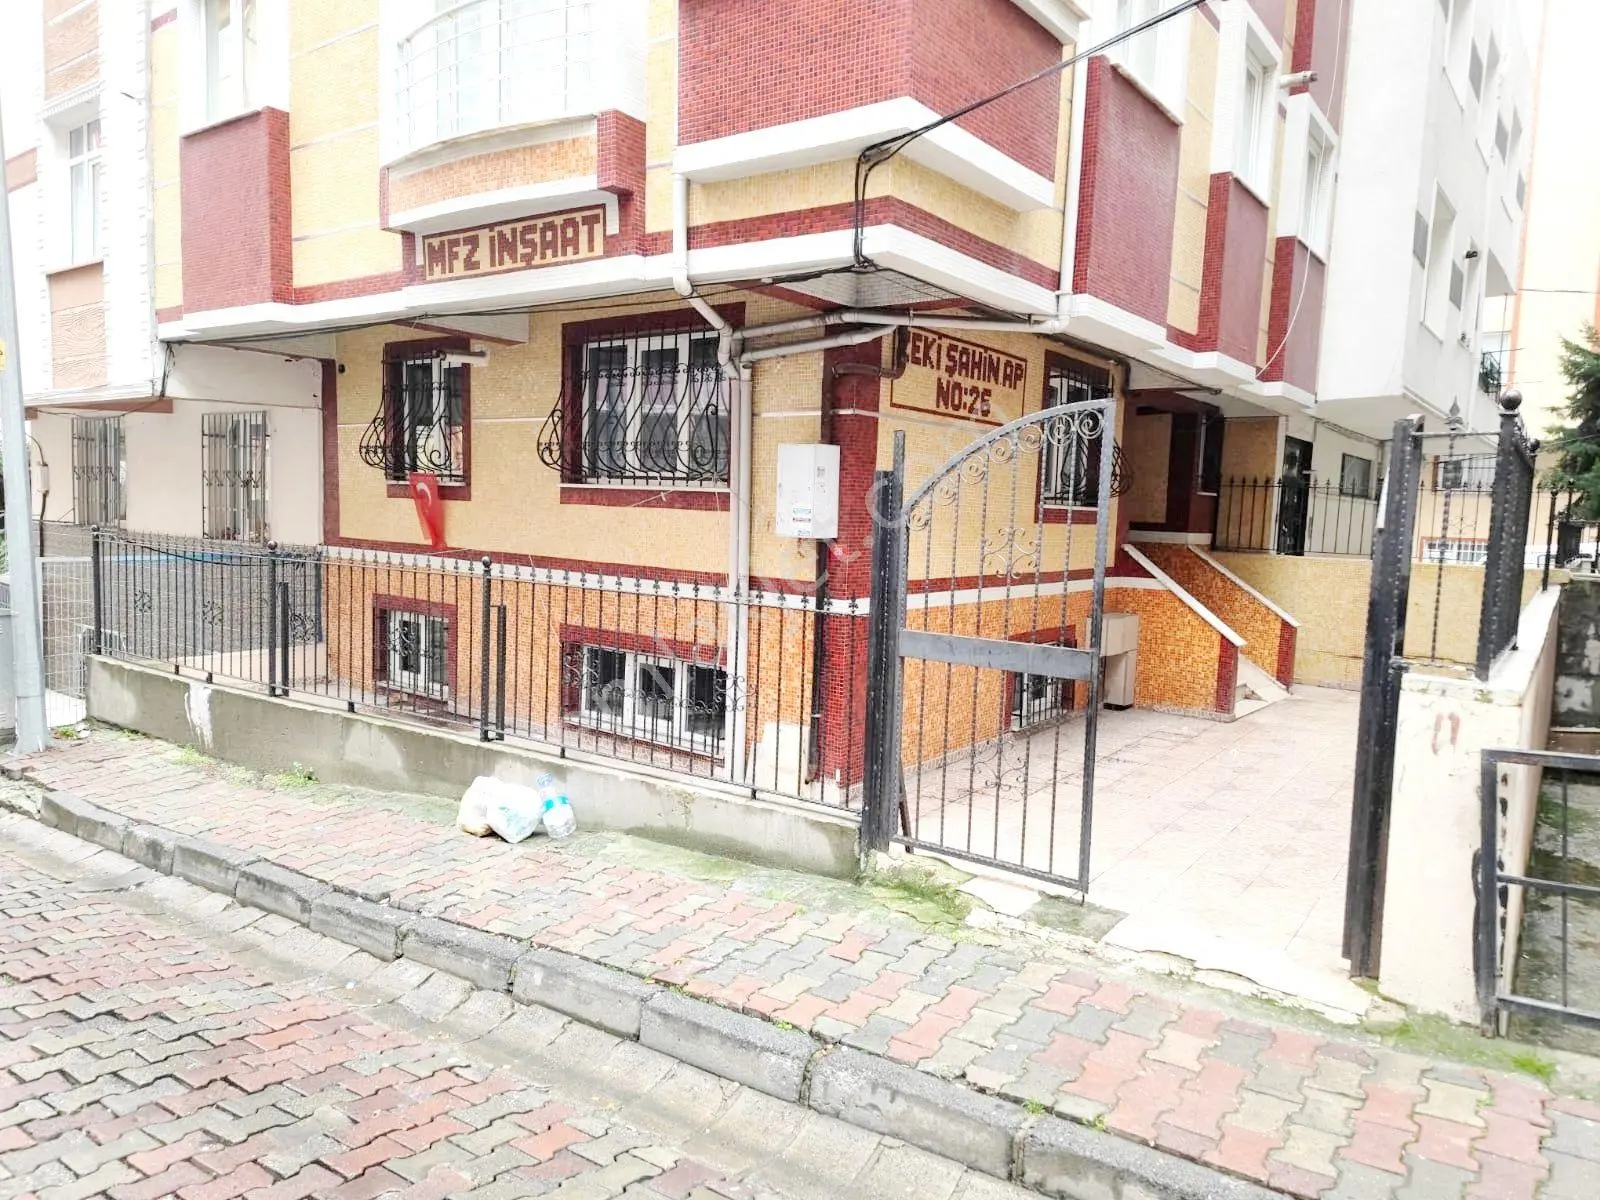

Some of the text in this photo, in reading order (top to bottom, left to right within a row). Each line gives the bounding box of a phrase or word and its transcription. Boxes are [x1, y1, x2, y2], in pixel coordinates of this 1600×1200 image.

[427, 214, 601, 276] MFZ İNŞAAT
[906, 330, 942, 371] EKİ
[1002, 359, 1025, 390] AP
